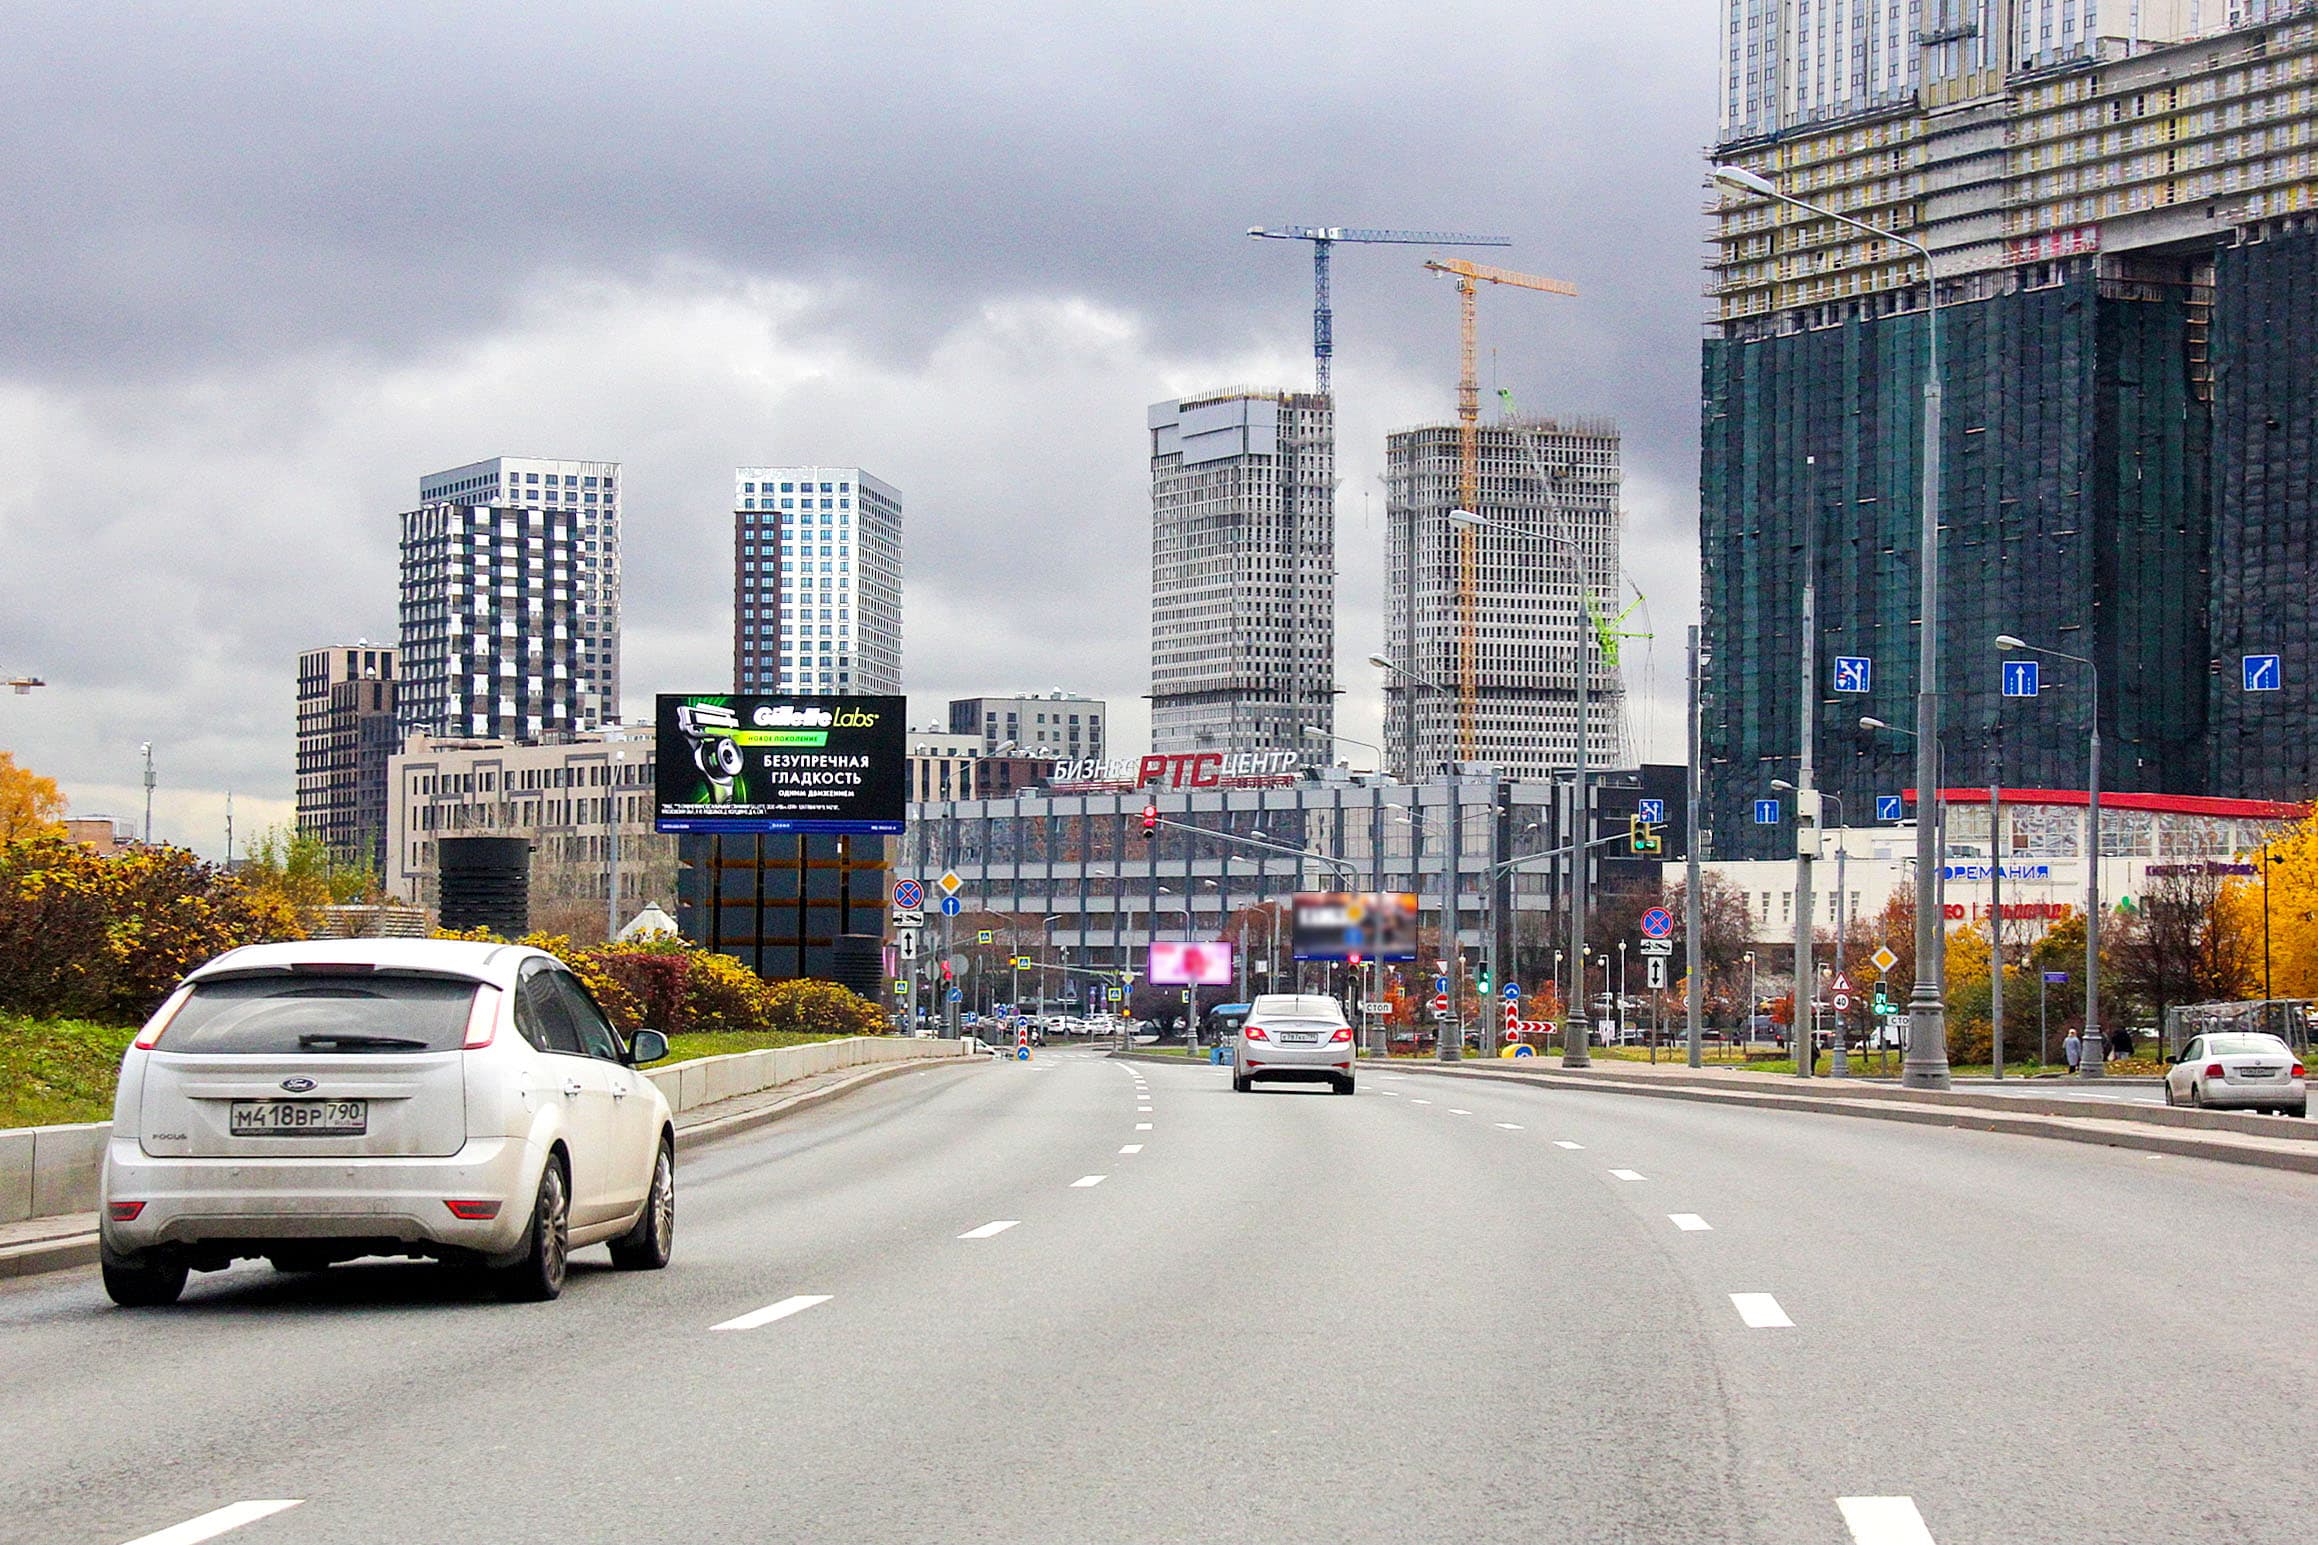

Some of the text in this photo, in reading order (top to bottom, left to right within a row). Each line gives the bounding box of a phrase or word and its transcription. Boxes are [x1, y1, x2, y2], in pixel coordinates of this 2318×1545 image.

[833, 706, 875, 728] Labs
[763, 754, 870, 769] БЕЗУПРЕЧНАЯ
[1136, 753, 1223, 789] РТС
[1221, 751, 1298, 777] ЦЕНТР
[771, 771, 862, 786] ГЛАДКОСТЬ
[1366, 1004, 1389, 1012] СТОП
[1836, 998, 1847, 1007] 40
